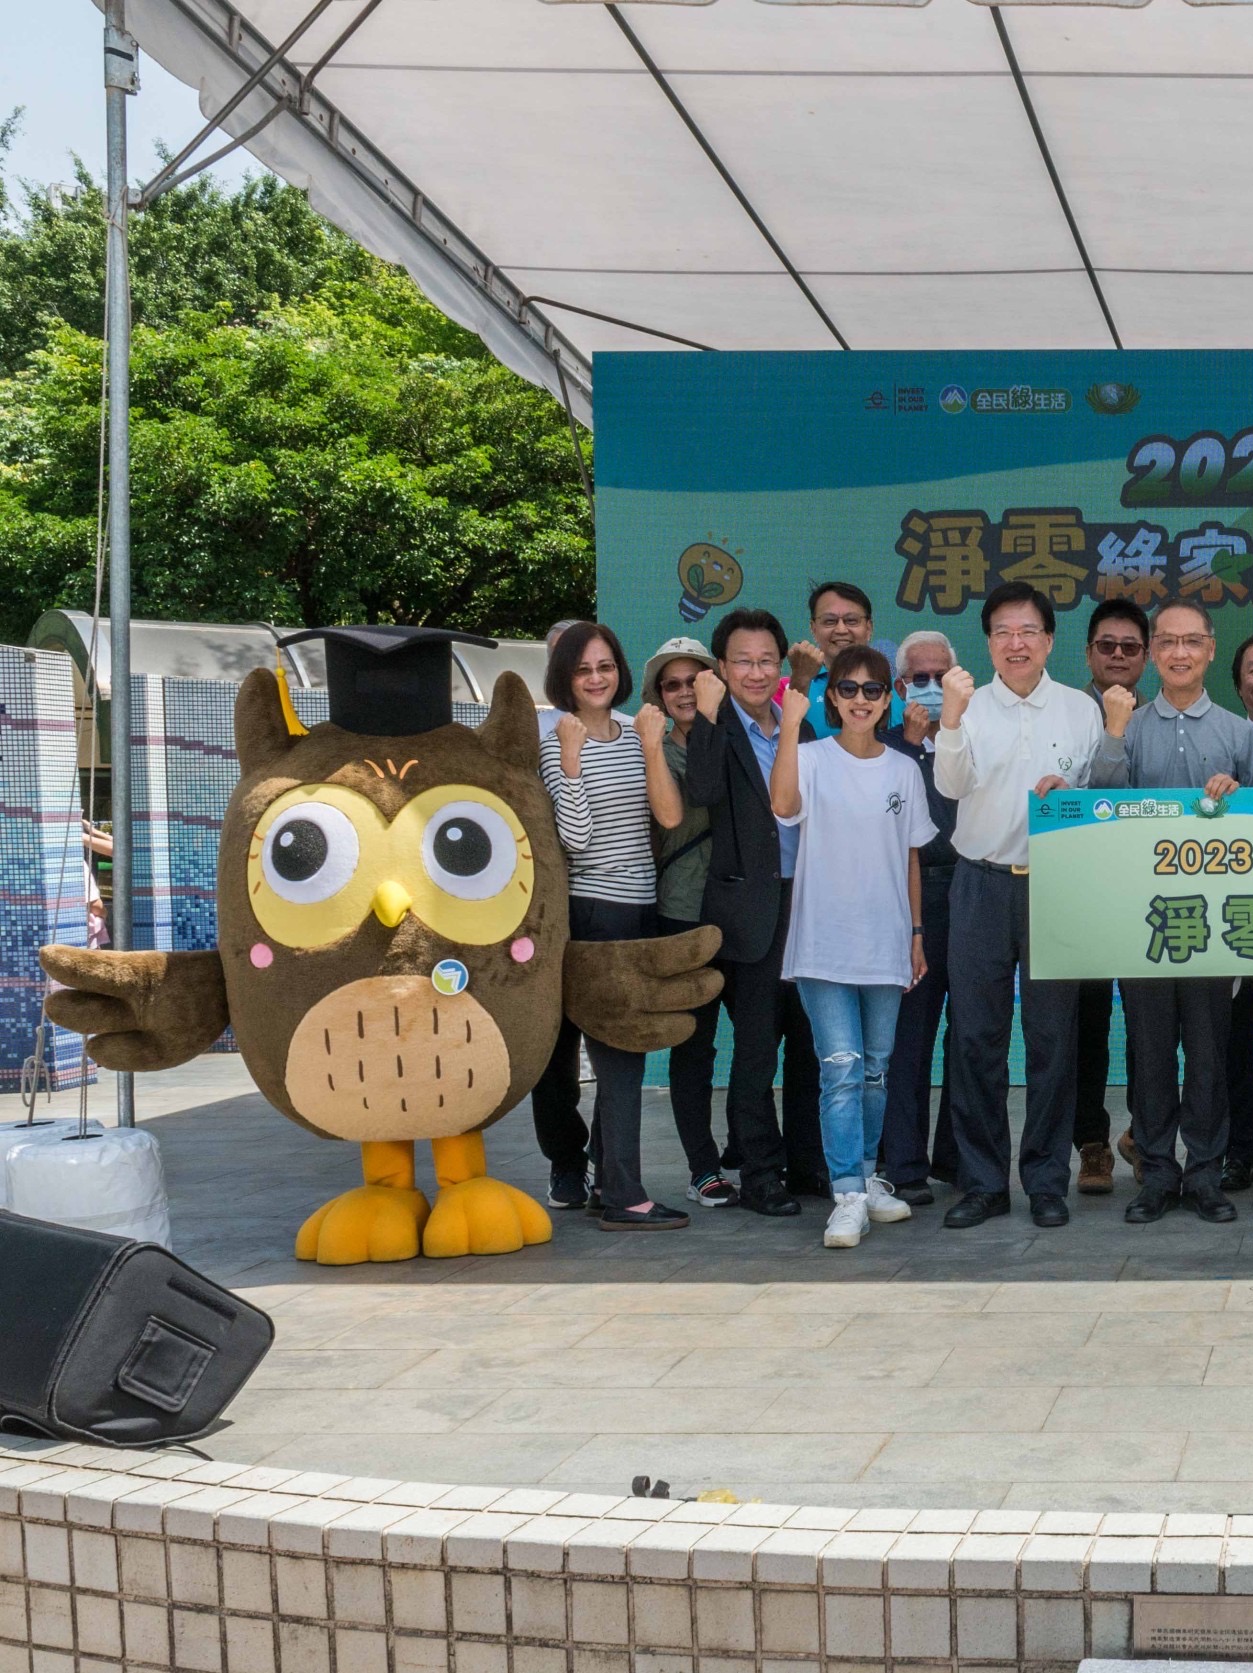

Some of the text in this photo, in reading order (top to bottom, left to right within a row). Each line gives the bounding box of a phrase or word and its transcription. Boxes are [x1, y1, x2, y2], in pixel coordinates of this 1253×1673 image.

[976, 386, 1067, 410] 全民綠生活
[1118, 800, 1179, 817] 全民綠生活
